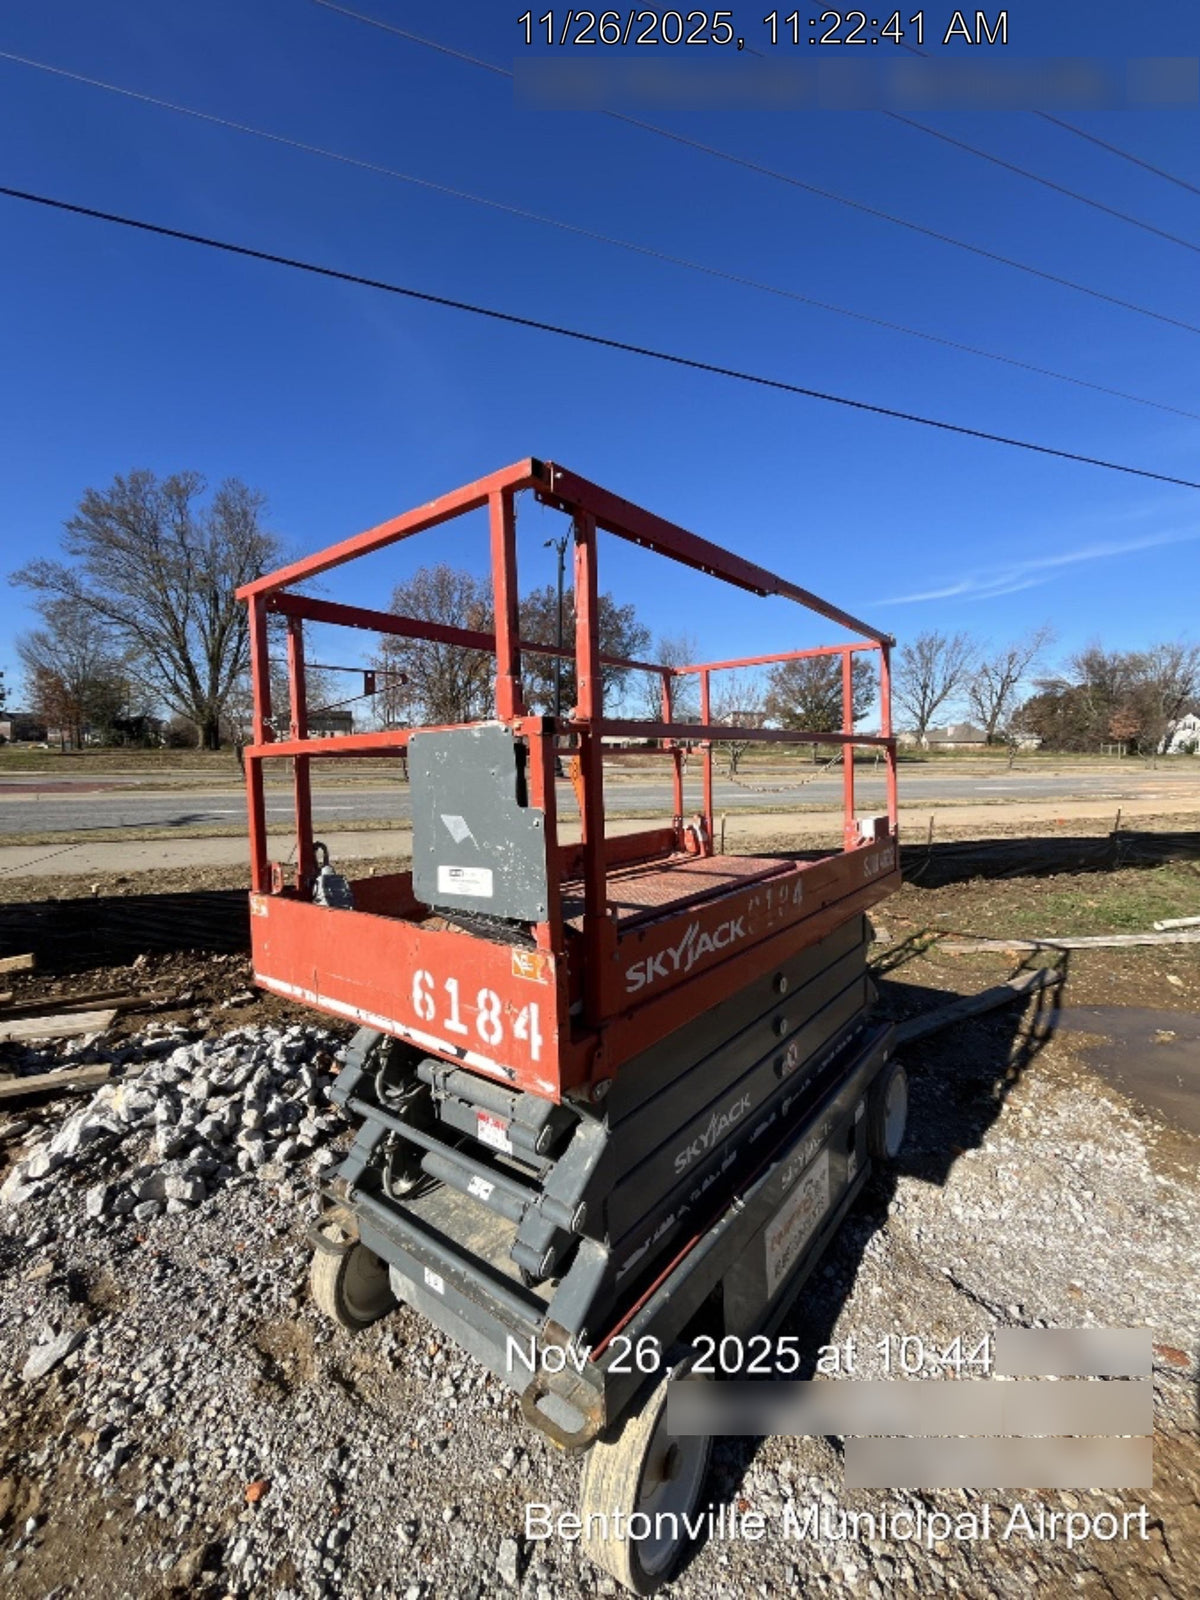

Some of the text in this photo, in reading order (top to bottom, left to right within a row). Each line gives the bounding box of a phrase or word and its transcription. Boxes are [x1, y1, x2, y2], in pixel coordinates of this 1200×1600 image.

[625, 919, 746, 993] SKYJACK
[412, 969, 543, 1062] 6184
[673, 1093, 751, 1174] SKYJACK
